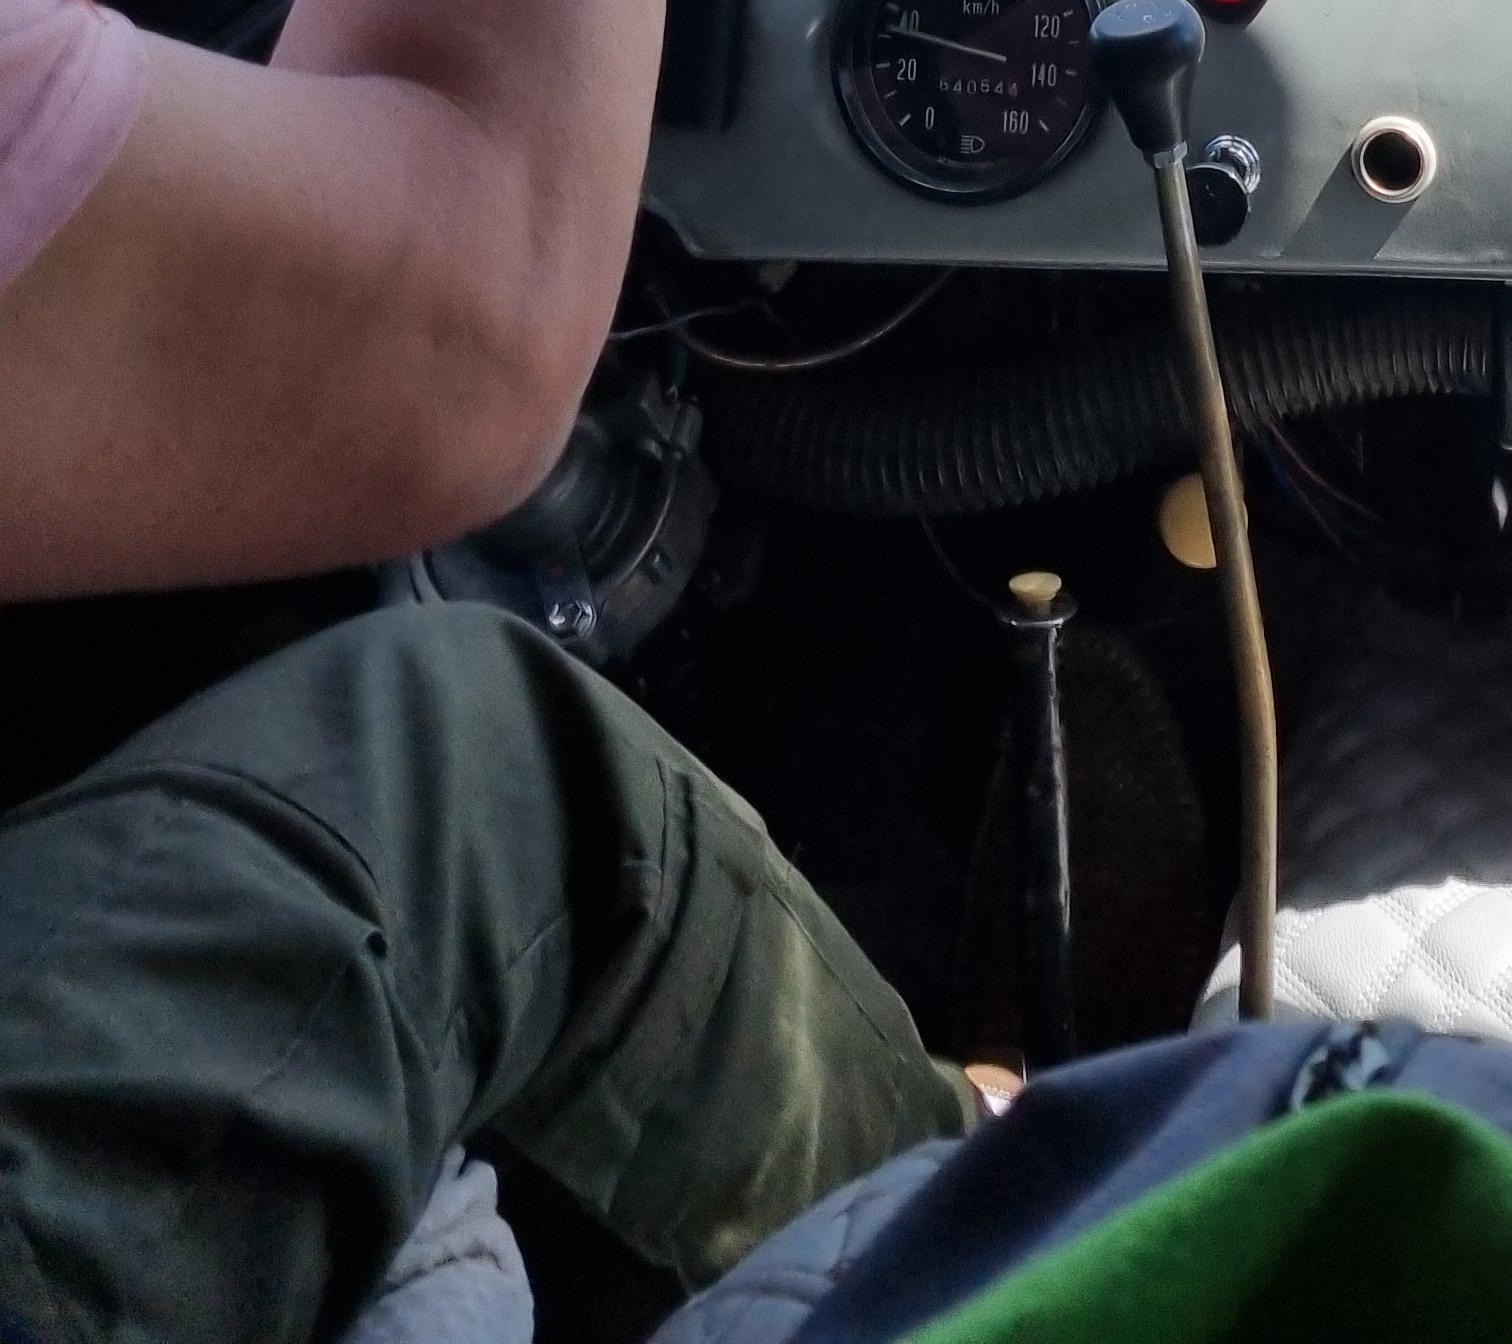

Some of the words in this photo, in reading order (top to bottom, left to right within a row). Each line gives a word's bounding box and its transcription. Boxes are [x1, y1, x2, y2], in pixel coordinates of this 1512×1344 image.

[899, 9, 920, 33] 40
[1033, 14, 1060, 39] 120
[896, 58, 917, 81] 20
[1031, 62, 1057, 87] 140
[925, 106, 935, 130] 0
[1002, 109, 1029, 135] 160
